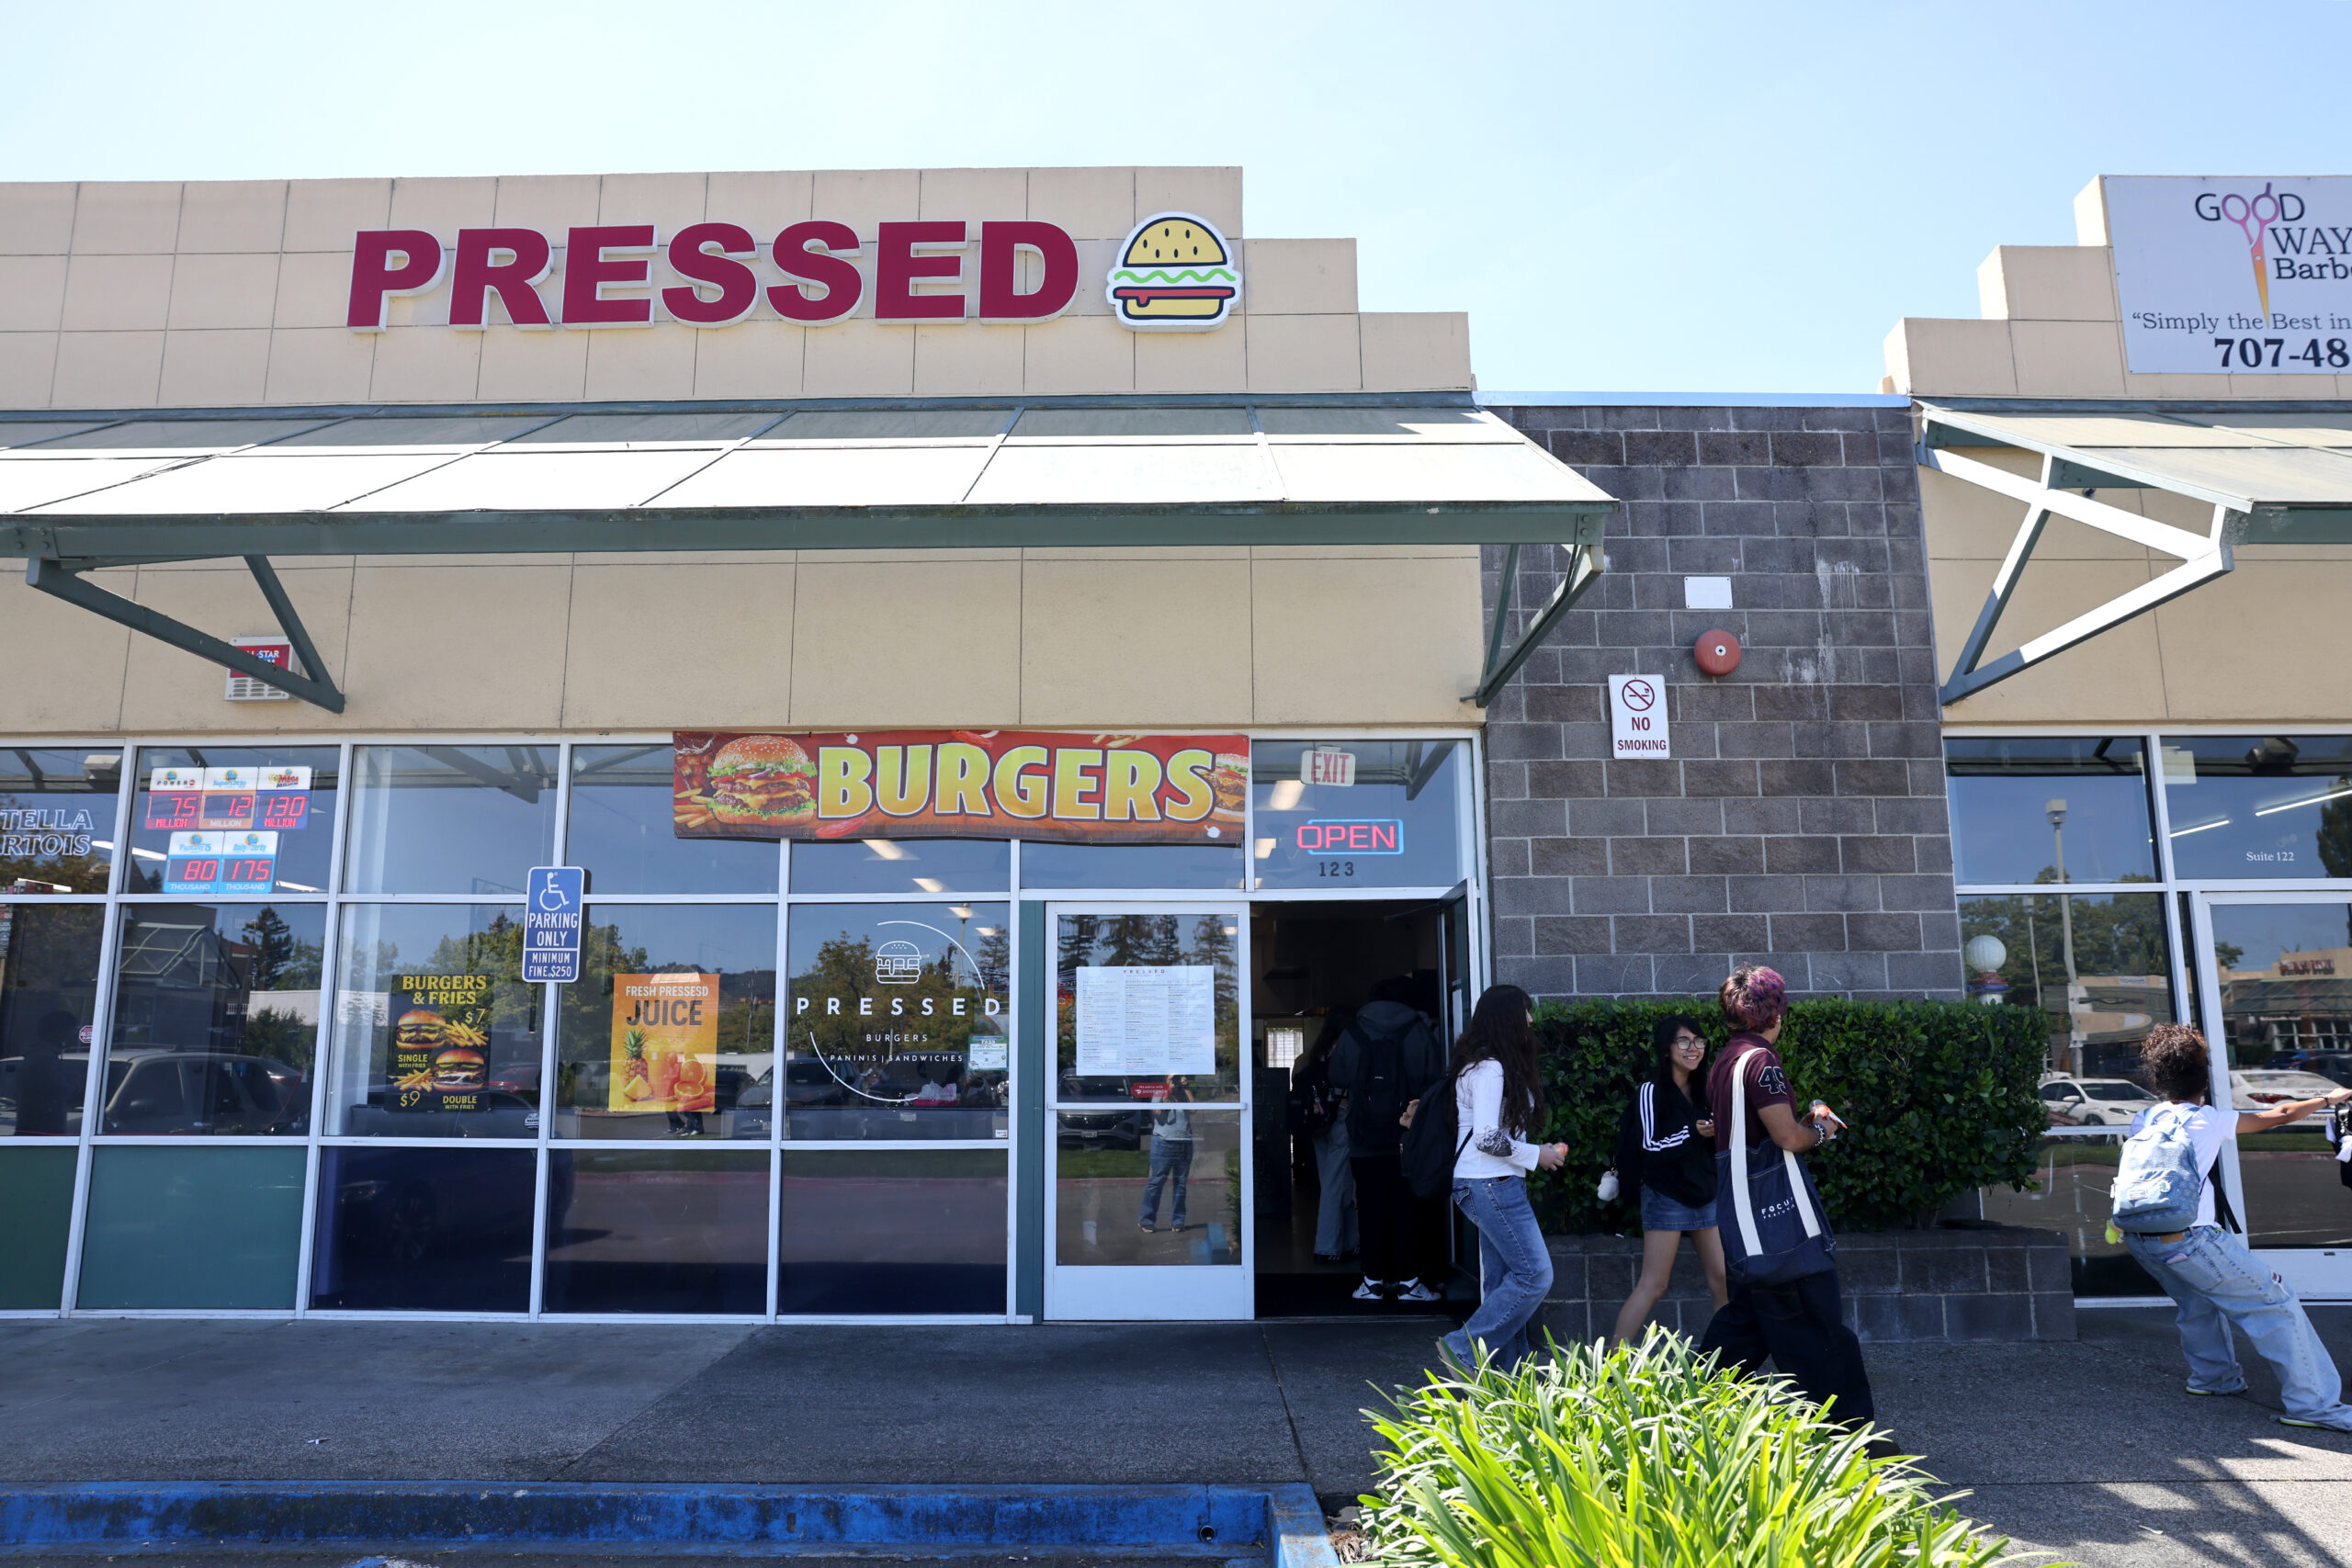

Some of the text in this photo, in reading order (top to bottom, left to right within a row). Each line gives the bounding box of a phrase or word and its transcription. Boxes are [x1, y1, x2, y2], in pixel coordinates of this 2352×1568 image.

[2195, 182, 2306, 224] GOOD
[346, 220, 1080, 332] PRESSED
[2227, 312, 2264, 330] the
[2271, 313, 2323, 330] Best
[257, 649, 280, 659] STAR
[1631, 716, 1651, 731] NO
[1617, 739, 1667, 750] SMOKING
[1310, 752, 1350, 784] EXIT
[816, 740, 1216, 823] BURGERS
[171, 797, 198, 817] 75
[229, 796, 253, 817] 12
[266, 796, 306, 817] 130
[155, 818, 189, 828] MILLION
[209, 819, 243, 828] MILLION
[264, 818, 297, 828] MILLION
[1297, 825, 1395, 849] OPEN
[2246, 852, 2294, 862] Suite 122
[184, 860, 218, 881] 80
[232, 860, 273, 881] 175
[1318, 862, 1354, 877] 123
[528, 913, 578, 929] PARKING
[537, 931, 568, 947] ONLY
[532, 953, 571, 964] MINIMUM
[528, 964, 571, 977] FINE $250
[402, 975, 487, 990] BURGERS
[413, 991, 477, 1005] & FRIES
[626, 986, 709, 997] FRESH PRESSESD
[627, 999, 703, 1026] JUICE
[797, 998, 1001, 1016] PRESSED
[398, 1054, 428, 1063] SINGLE
[442, 1095, 478, 1104] DOUBLE
